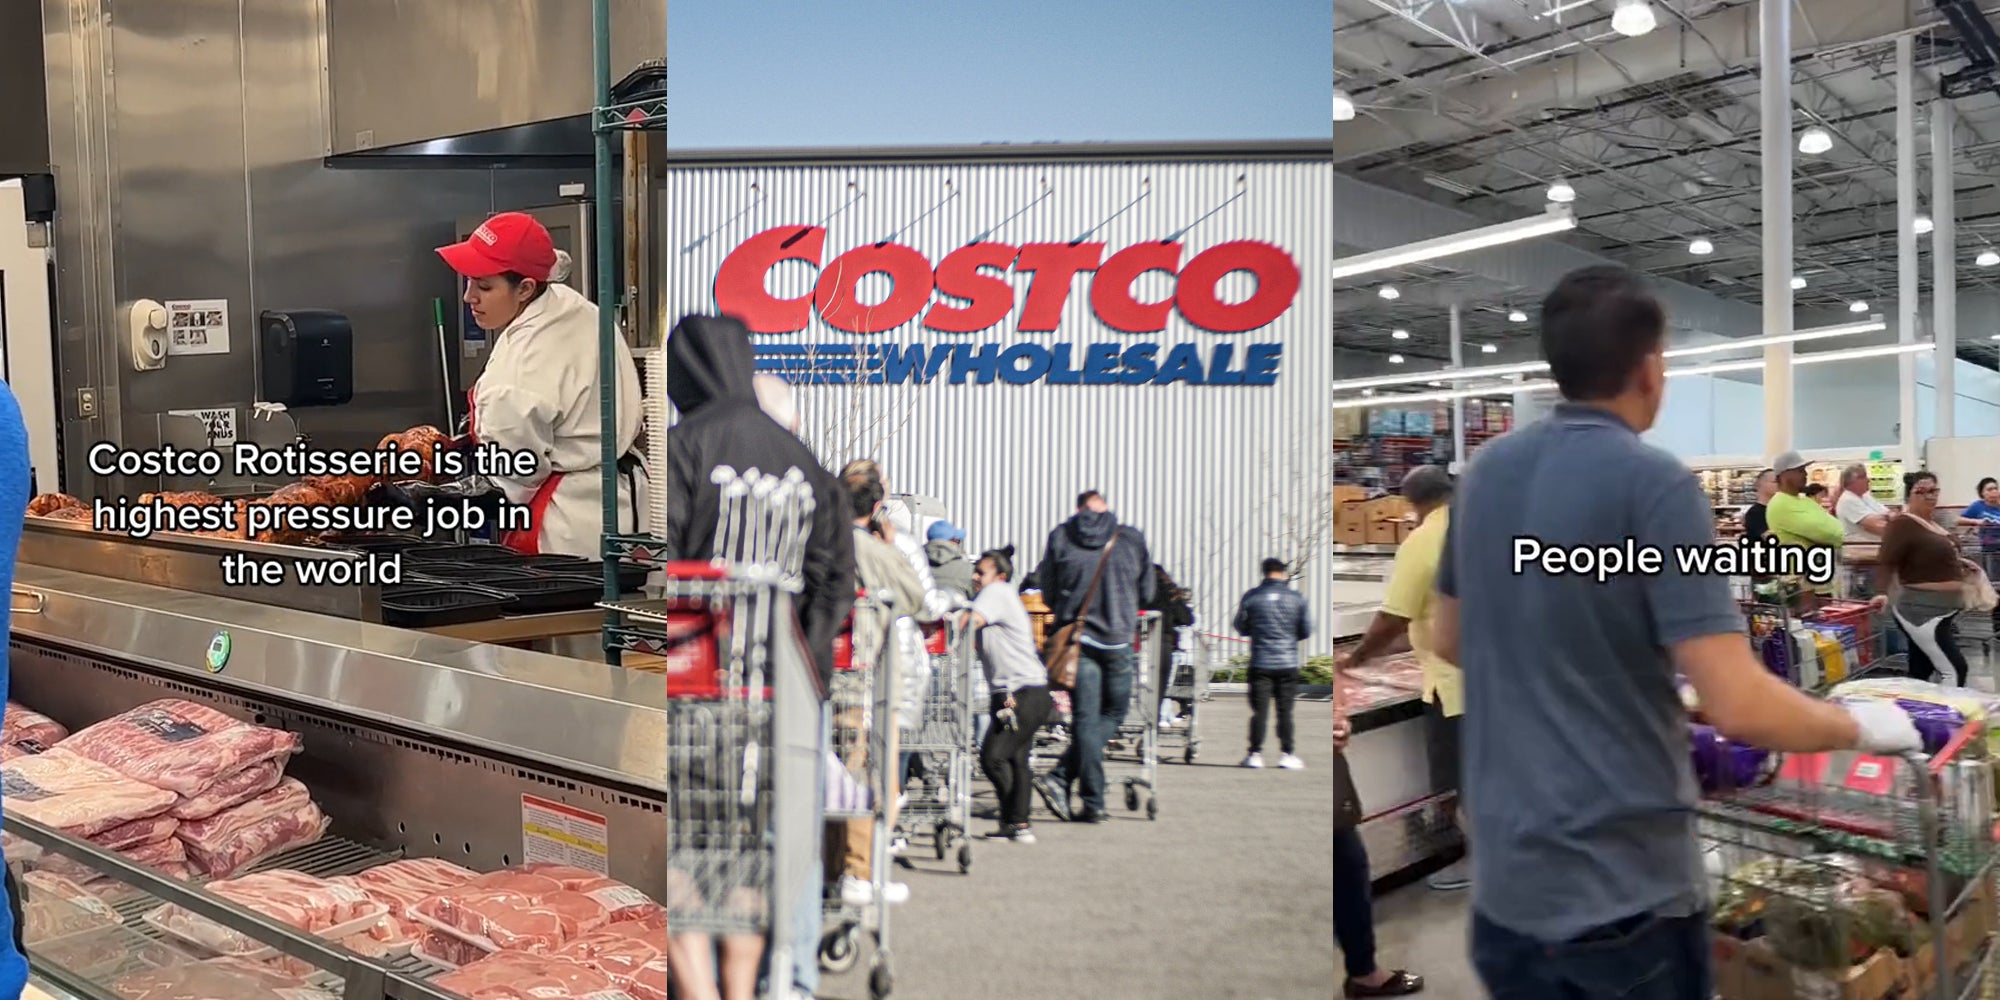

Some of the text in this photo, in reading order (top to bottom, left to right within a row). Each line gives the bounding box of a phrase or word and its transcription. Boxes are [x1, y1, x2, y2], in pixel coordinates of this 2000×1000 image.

[713, 224, 1301, 334] COSTCO
[880, 342, 1283, 387] WHOLESALE
[207, 429, 234, 439] ANDS
